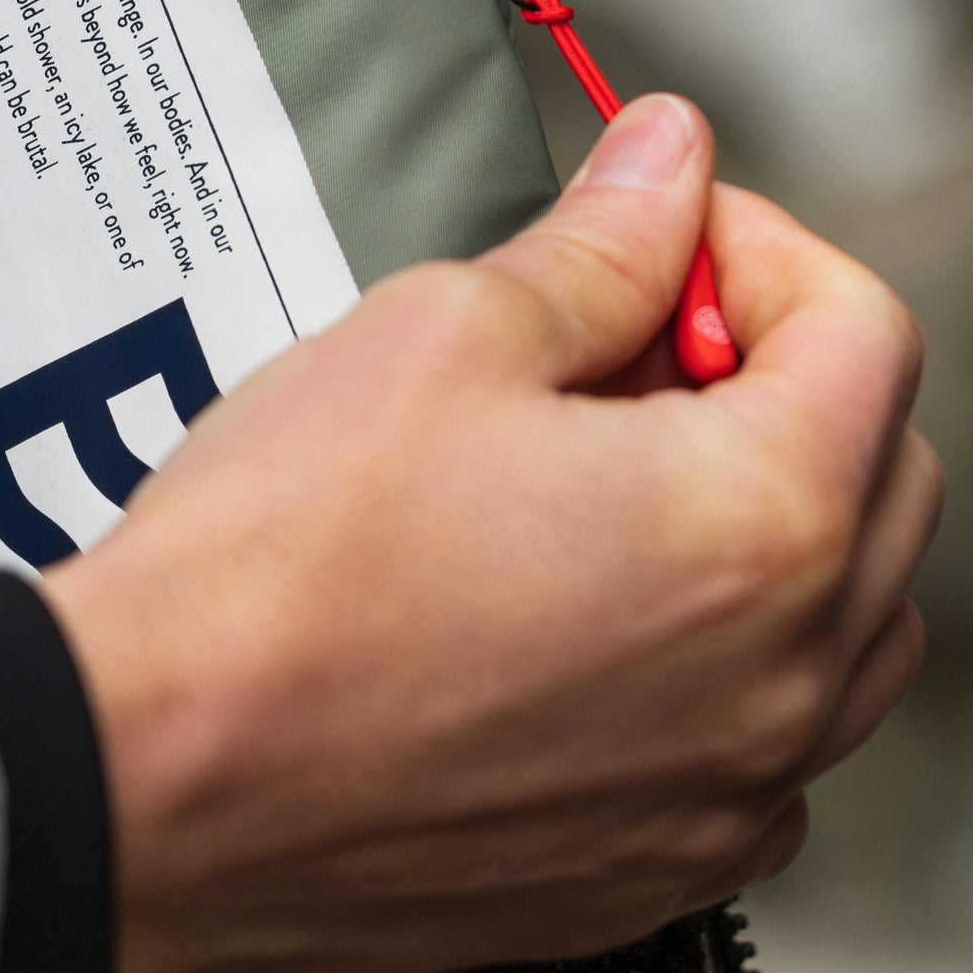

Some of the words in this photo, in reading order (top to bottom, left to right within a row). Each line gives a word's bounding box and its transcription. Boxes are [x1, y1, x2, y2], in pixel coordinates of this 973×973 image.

[27, 22, 62, 92] shower,
[80, 5, 125, 77] beyond
[137, 36, 159, 61] In
[107, 73, 132, 115] how
[146, 63, 169, 92] our
[7, 89, 31, 119] be
[54, 92, 72, 116] an
[61, 113, 85, 145] icy
[123, 117, 143, 145] we
[159, 92, 192, 160] bodies.
[17, 115, 59, 180] brutal.
[76, 143, 103, 191] lake,
[135, 144, 166, 189] feel,
[184, 161, 219, 202] And
[95, 192, 113, 210] or
[148, 189, 182, 234] right
[201, 198, 222, 222] in
[104, 215, 126, 250] one
[210, 224, 233, 253] our
[118, 252, 144, 271] of
[169, 235, 194, 279] now.
